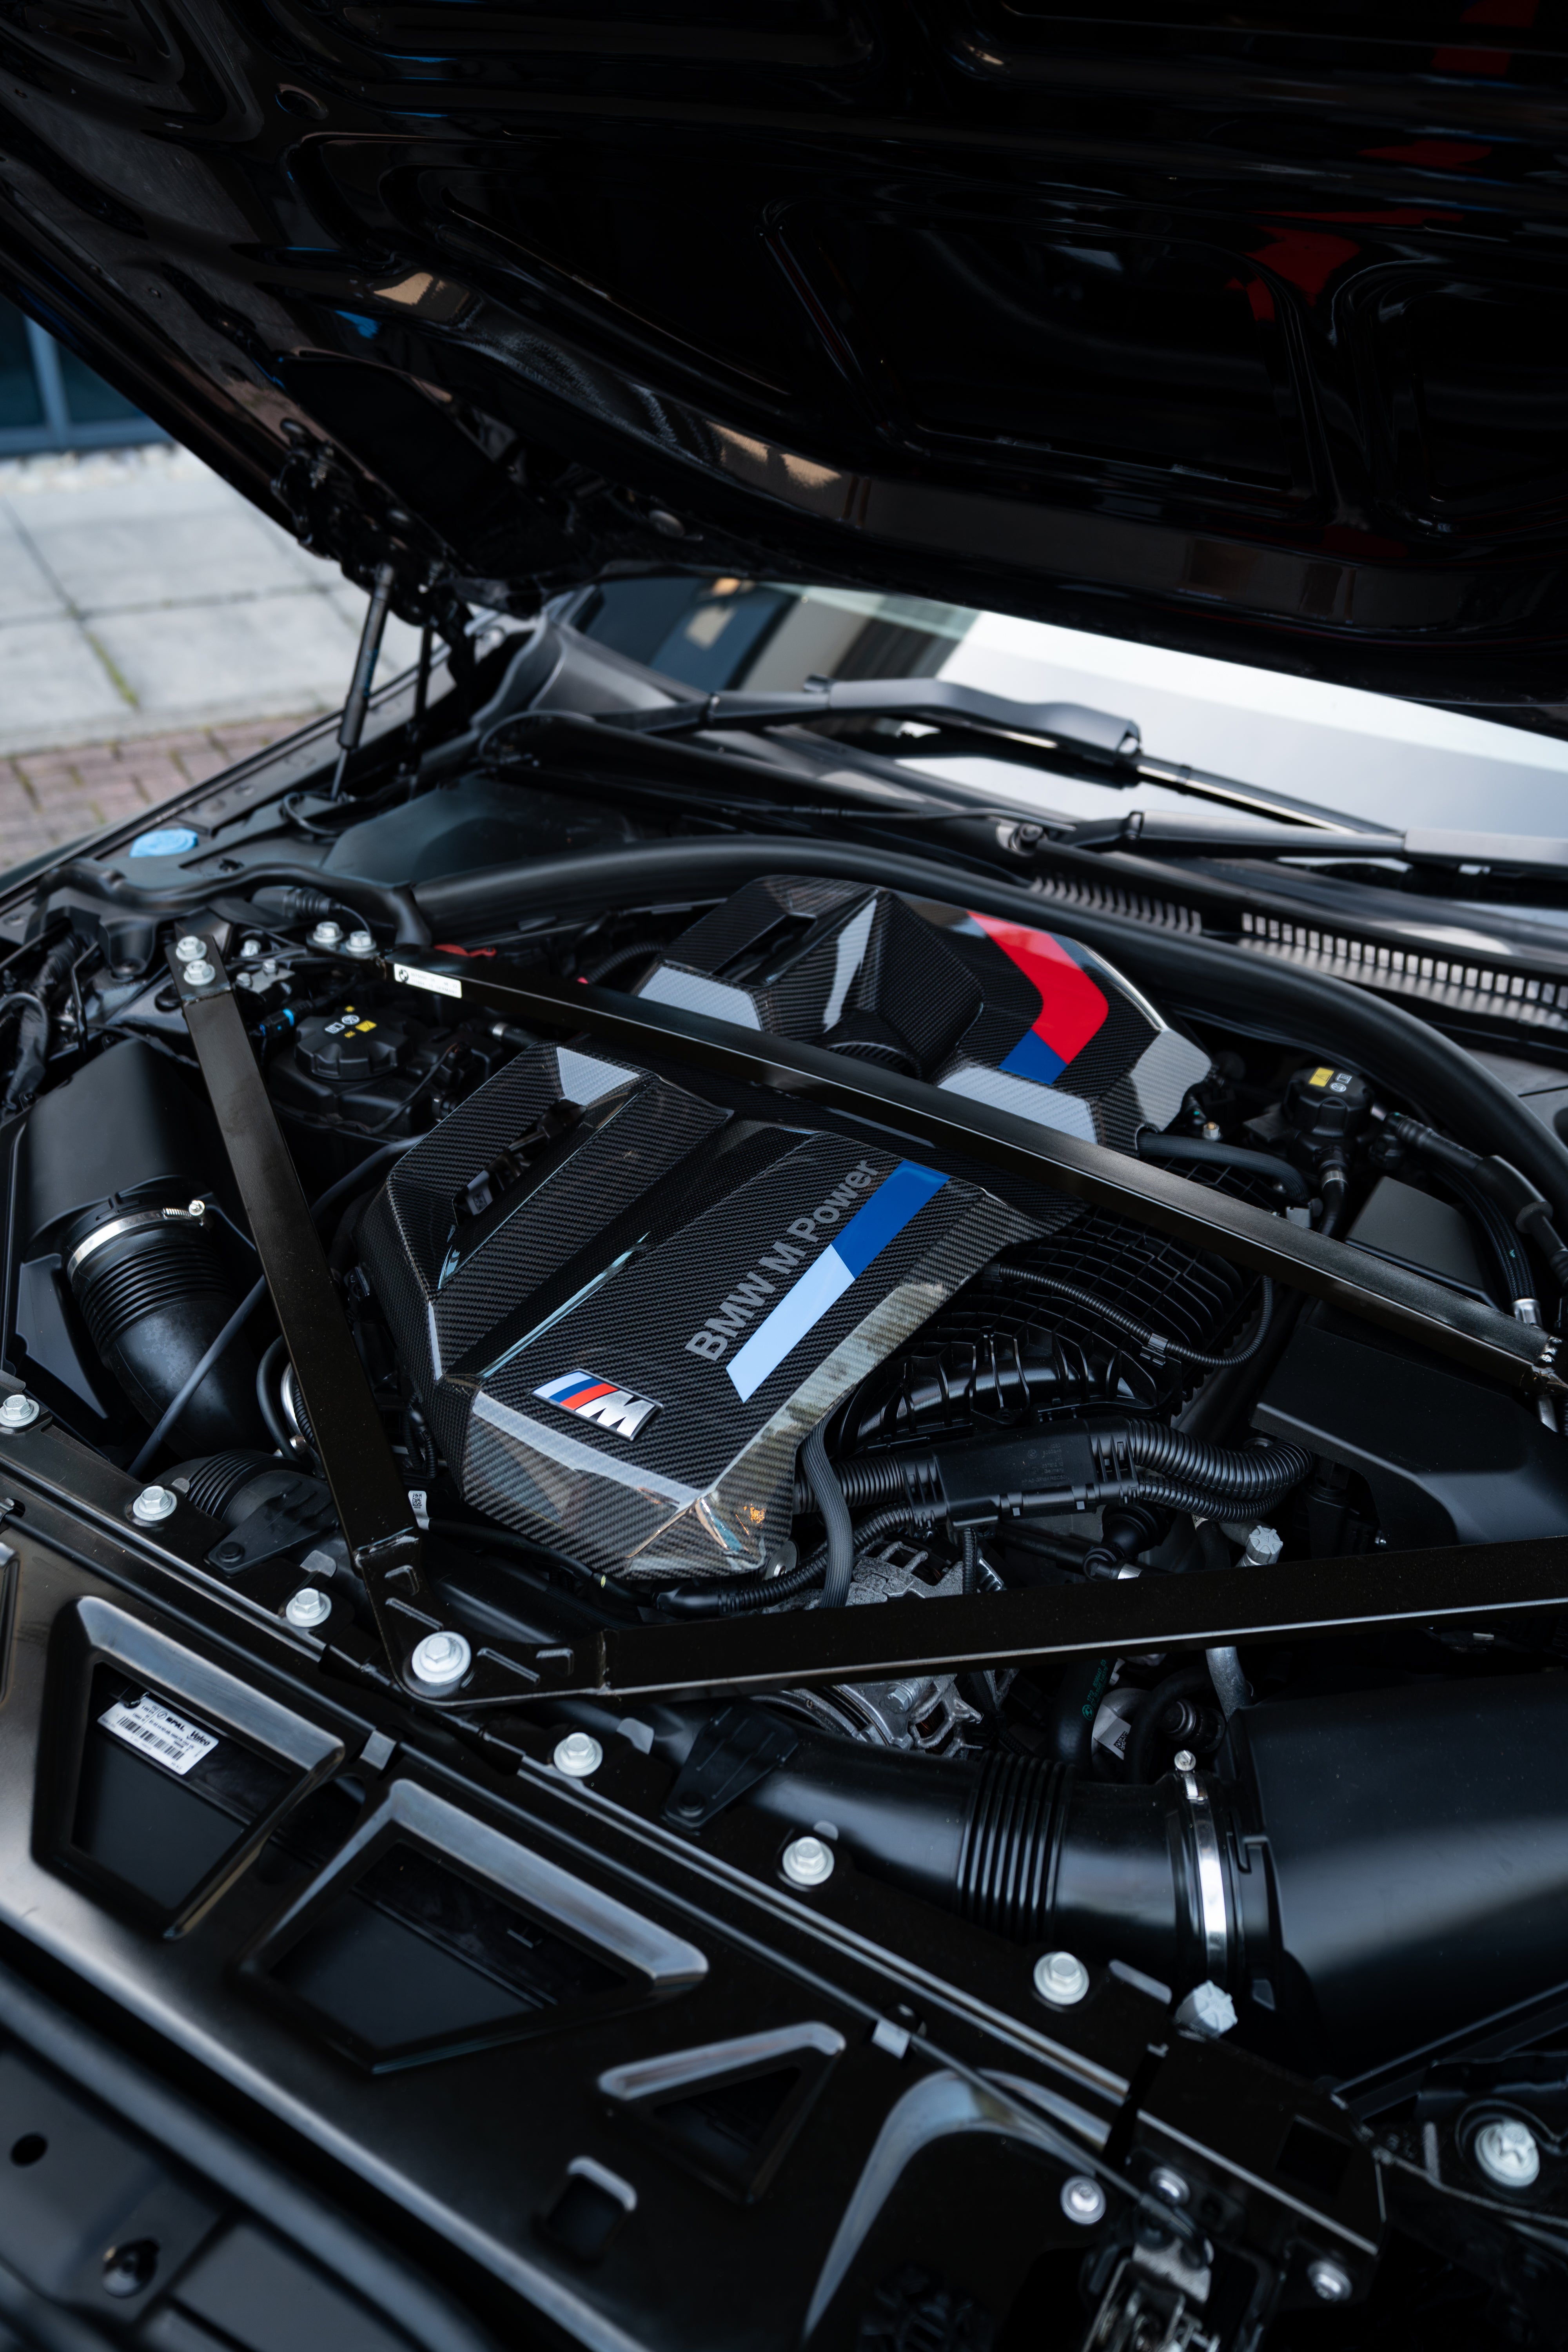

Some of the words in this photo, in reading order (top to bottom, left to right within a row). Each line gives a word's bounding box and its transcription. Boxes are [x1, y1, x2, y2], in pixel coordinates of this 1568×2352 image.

[684, 1271, 776, 1361] BMW
[758, 1241, 807, 1274] M
[786, 1160, 879, 1243] Power
[575, 1390, 655, 1437] M
[191, 1730, 211, 1746] Valeo
